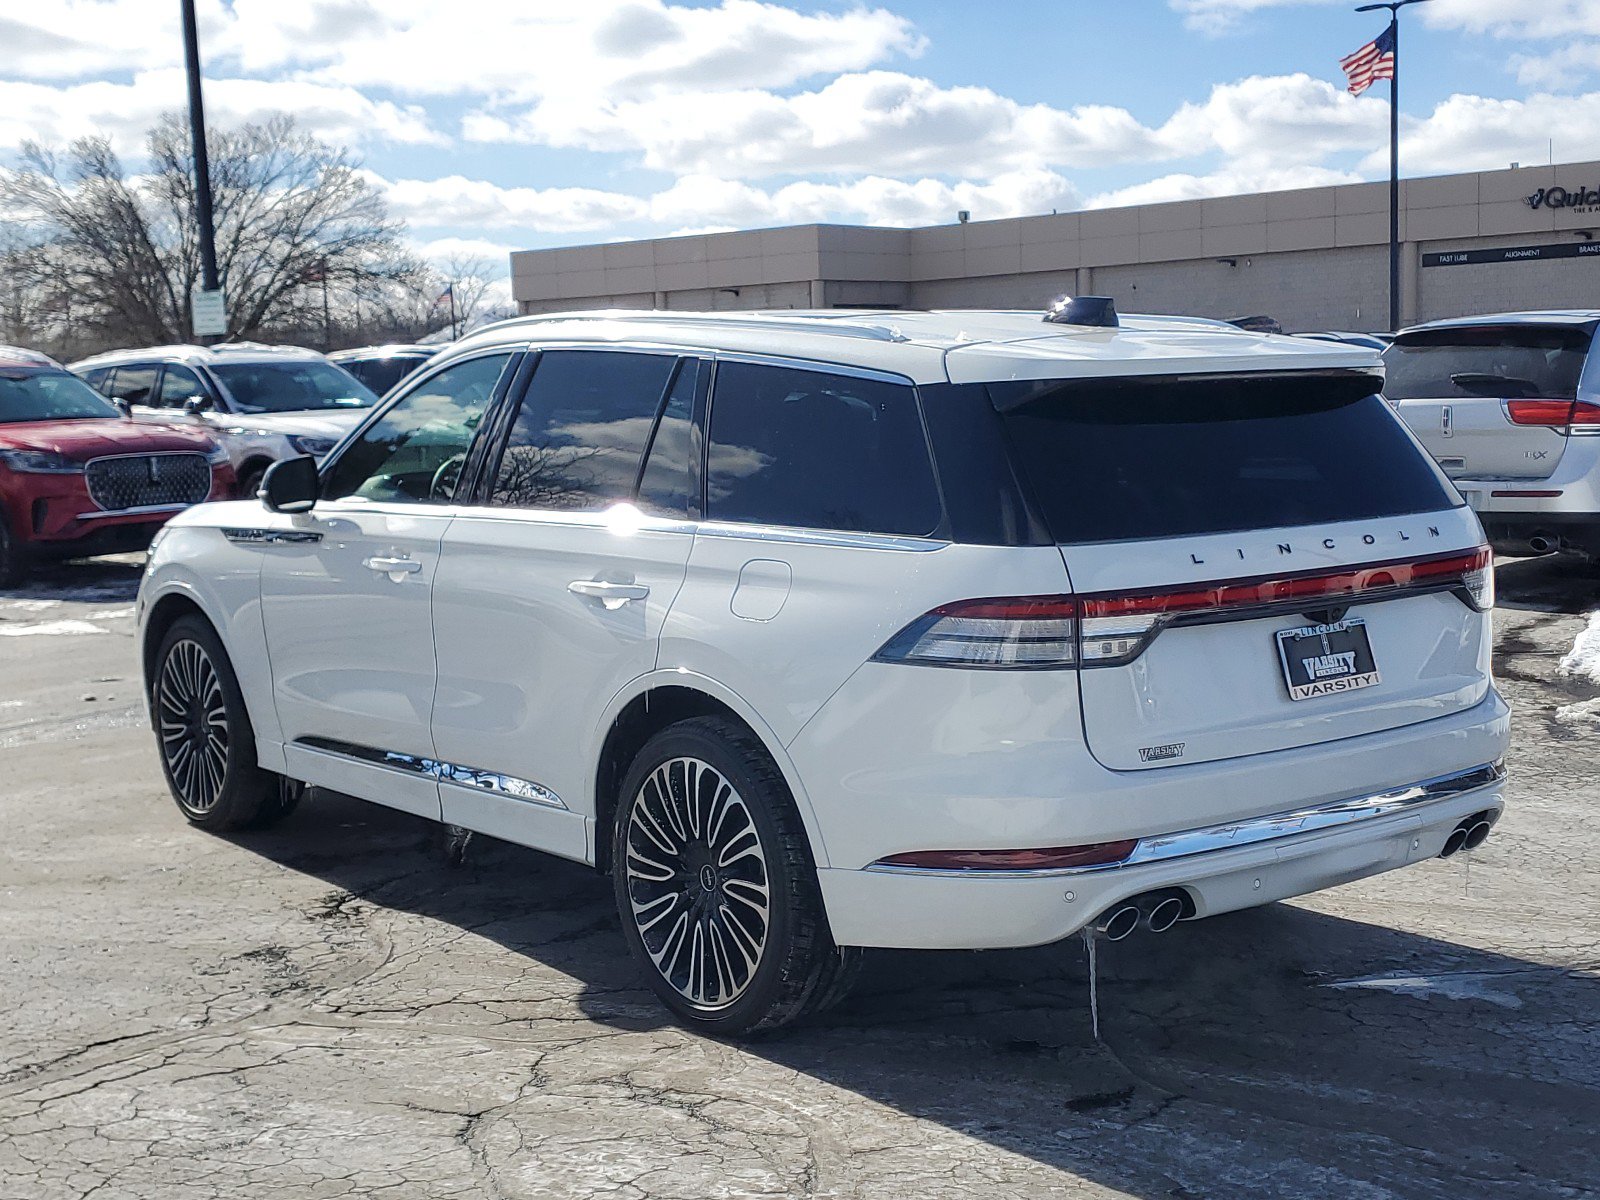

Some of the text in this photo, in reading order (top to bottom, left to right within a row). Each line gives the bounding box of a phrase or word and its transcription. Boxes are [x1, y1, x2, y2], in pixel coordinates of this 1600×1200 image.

[1544, 184, 1600, 209] Quic
[1439, 253, 1468, 263] FAST LUBE
[1504, 249, 1540, 258] ALIGNMENT
[1190, 525, 1440, 564] LINCOLN
[1300, 621, 1344, 637] LINCOLN
[1302, 651, 1356, 680] VARSITY
[1318, 666, 1346, 676] LINCOLN
[1299, 674, 1371, 697] VARSITY
[1139, 742, 1185, 762] VARSITY
